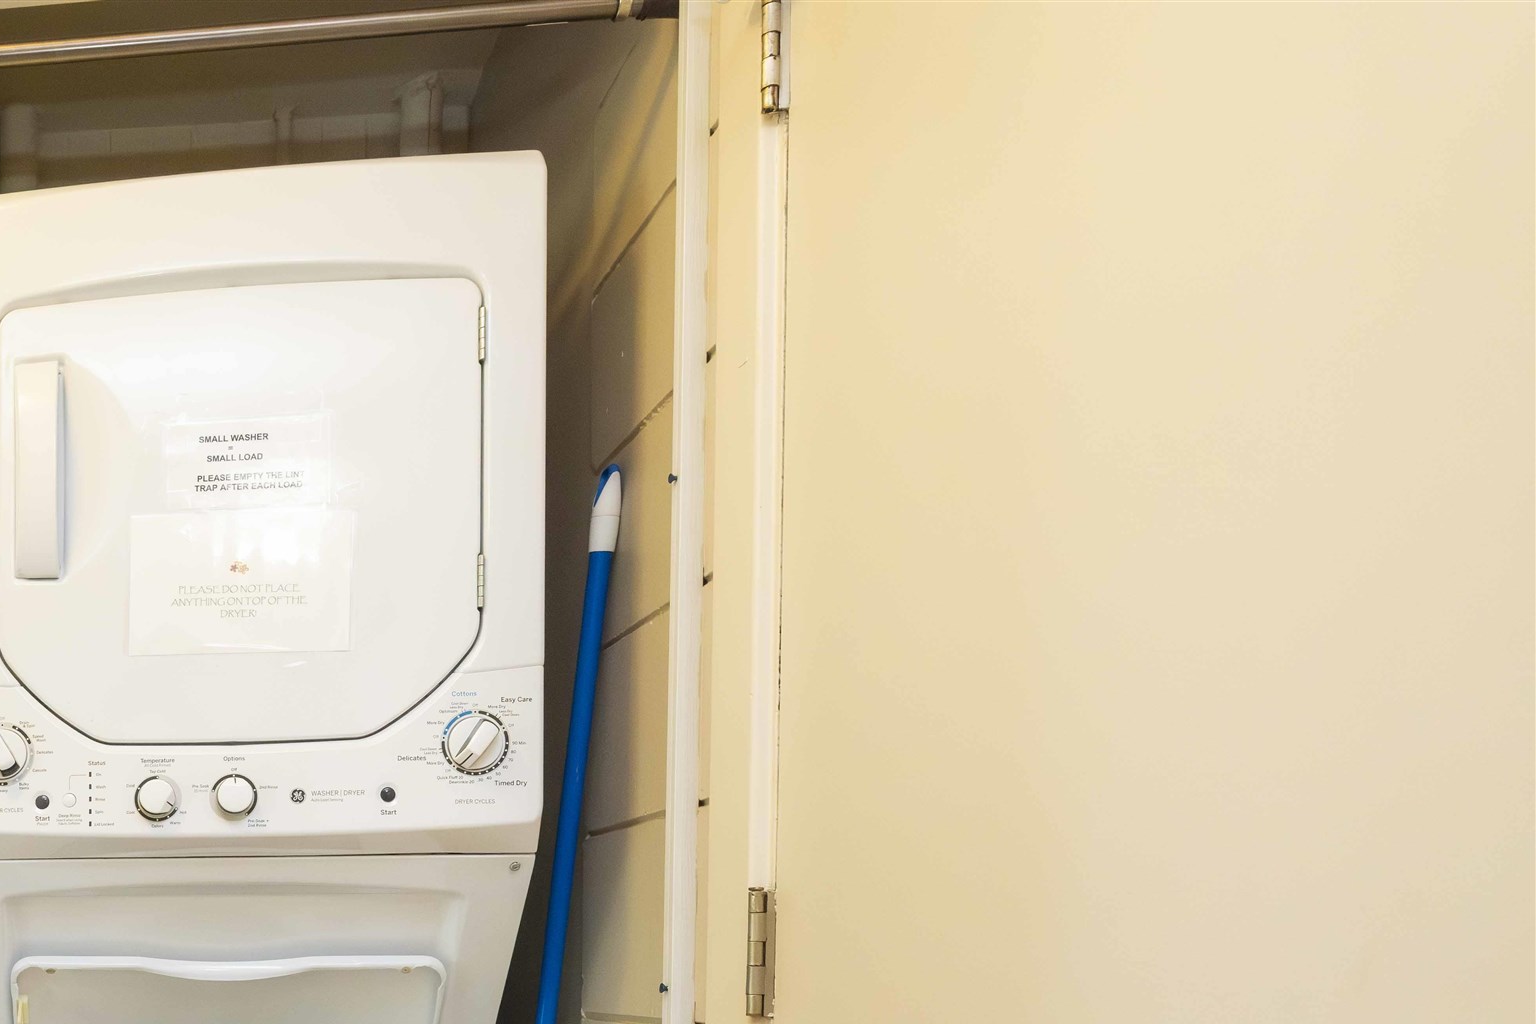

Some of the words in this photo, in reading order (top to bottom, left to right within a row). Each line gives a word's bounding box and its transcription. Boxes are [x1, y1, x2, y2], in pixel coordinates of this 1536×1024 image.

[199, 435, 228, 444] SMALL
[231, 432, 269, 442] WASHER
[207, 454, 236, 463] SMALL
[238, 453, 263, 461] LOAD
[197, 474, 231, 483] PLEASE
[233, 472, 264, 482] EMPTY
[266, 471, 283, 480] THE
[285, 470, 305, 479] LINT
[195, 484, 218, 493] TRAP
[220, 482, 249, 491] AFTER
[251, 481, 276, 490] EACH
[278, 480, 303, 489] LOAD
[178, 585, 220, 595] PLEASE
[222, 584, 239, 594] DO
[240, 584, 263, 593] NOT
[265, 583, 300, 593] PLACE
[170, 597, 226, 607] ANYTHING
[226, 597, 242, 606] ON
[242, 596, 266, 606] TOP
[267, 595, 283, 605] OF
[283, 595, 307, 605] THE
